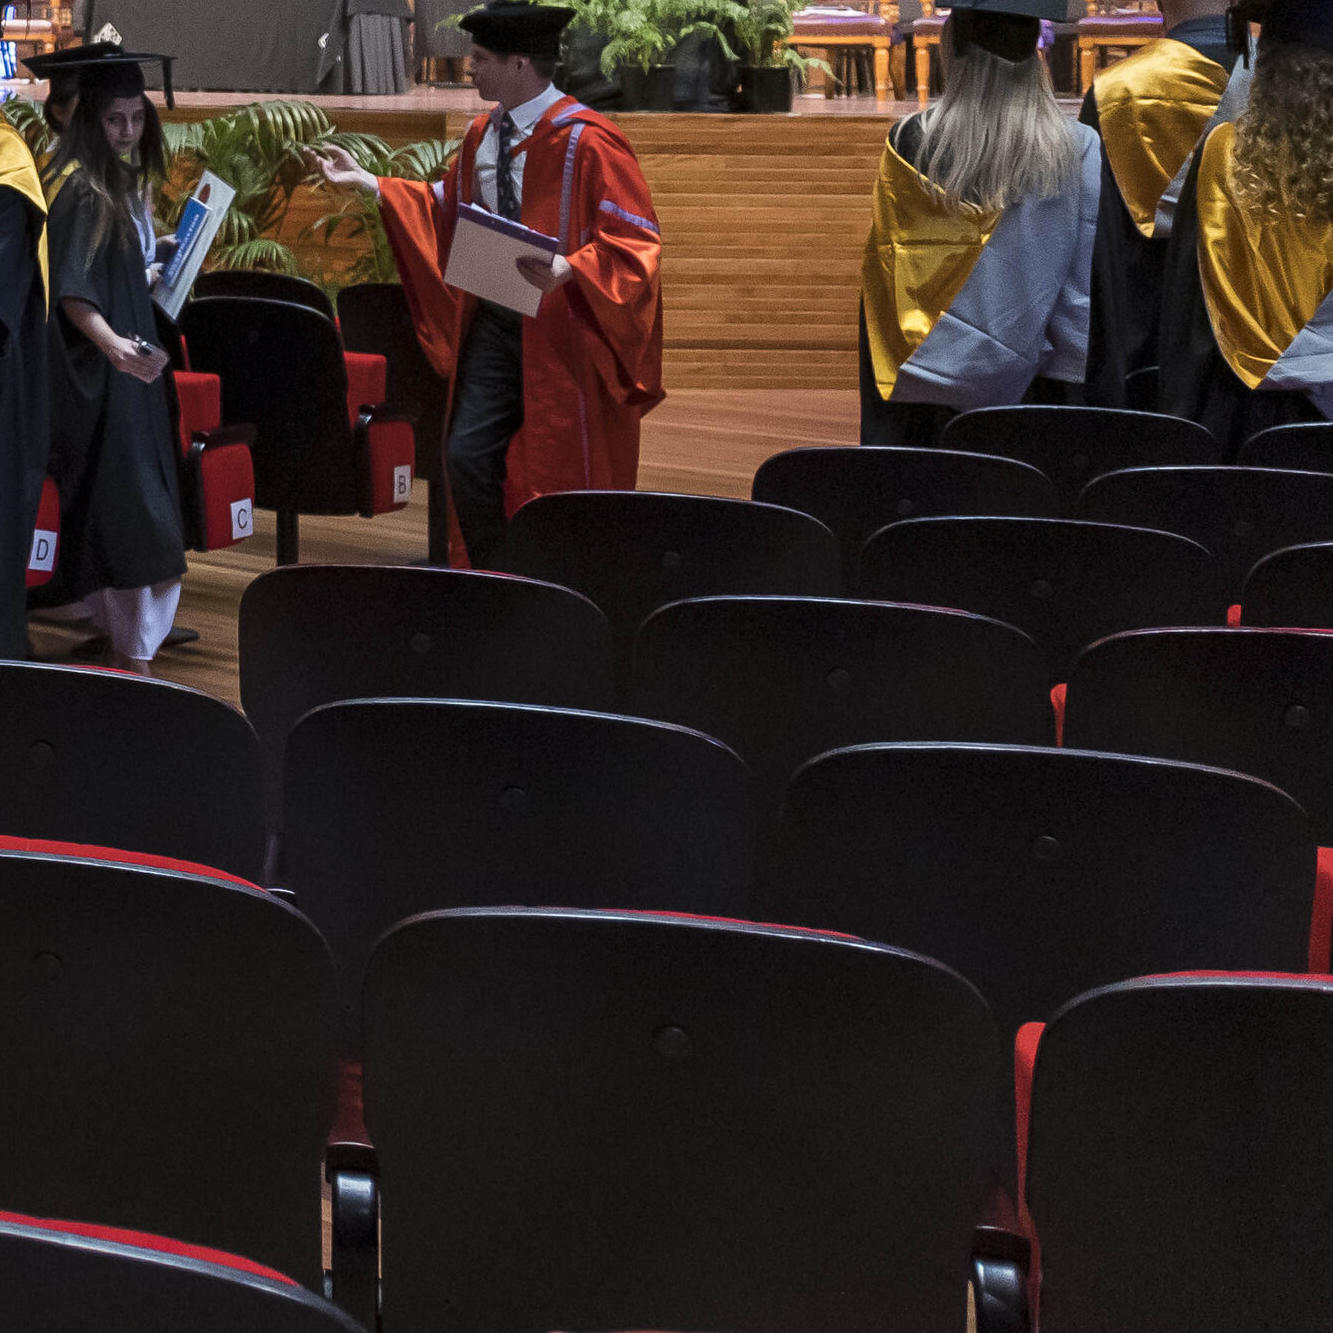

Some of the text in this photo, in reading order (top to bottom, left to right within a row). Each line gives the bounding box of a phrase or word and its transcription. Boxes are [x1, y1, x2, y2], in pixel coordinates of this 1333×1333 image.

[398, 474, 406, 495] B
[237, 508, 248, 530] C
[36, 538, 49, 561] D
